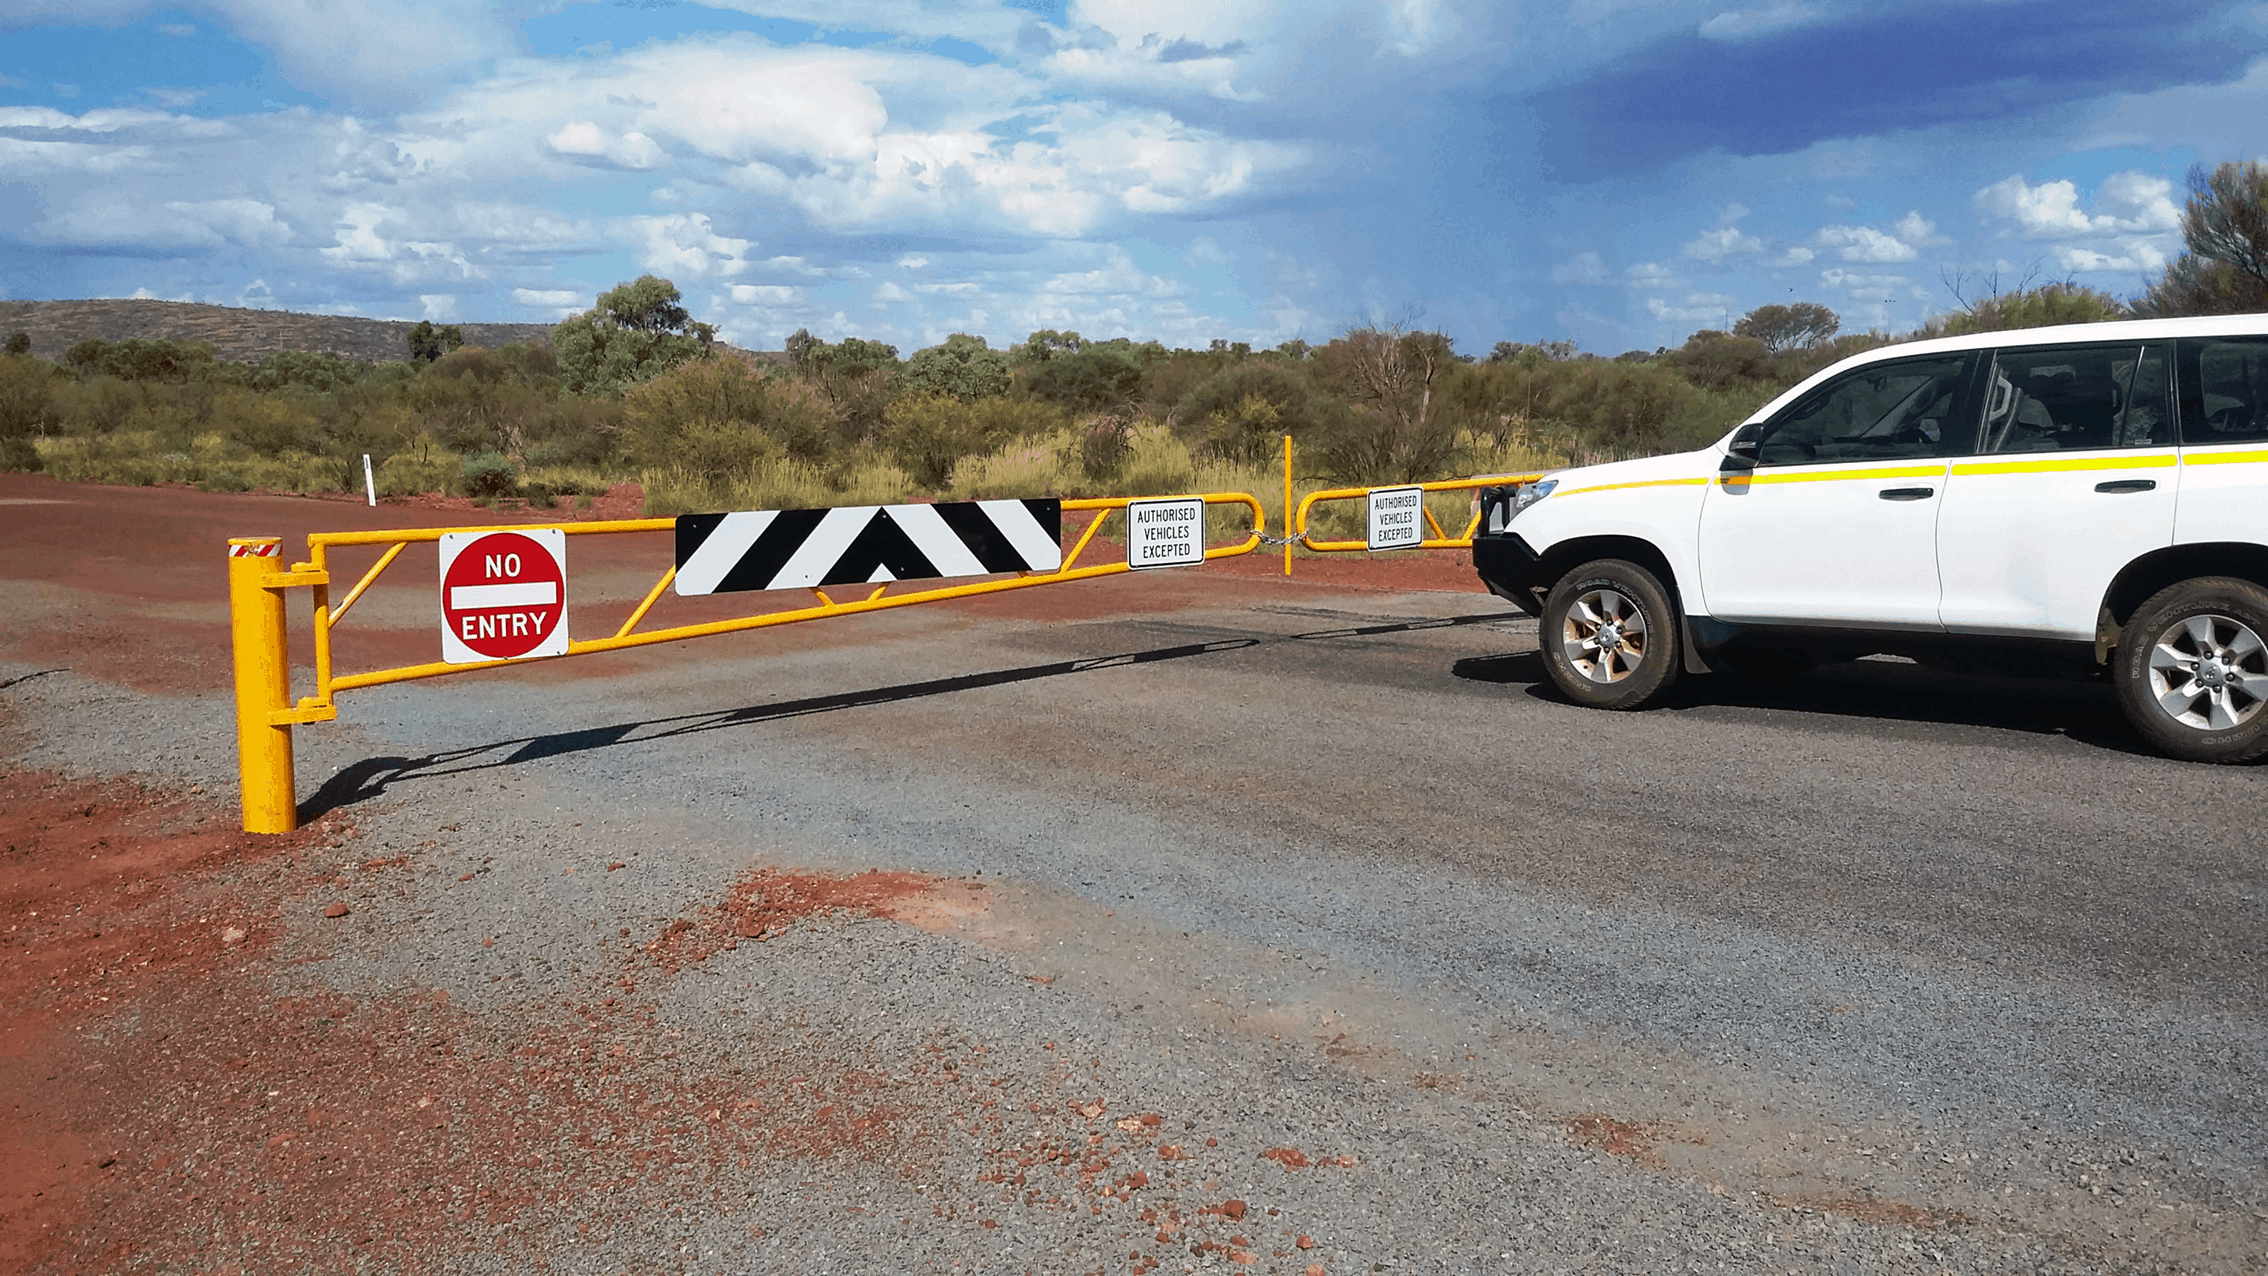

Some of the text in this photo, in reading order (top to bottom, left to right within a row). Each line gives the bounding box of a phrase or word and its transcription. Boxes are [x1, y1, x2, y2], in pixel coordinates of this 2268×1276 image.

[1374, 495, 1418, 510] AUTHORISED
[1137, 507, 1196, 524] AUTHORISED
[1379, 511, 1413, 525] VEHICLES
[1144, 525, 1190, 541] VEHICLES
[1378, 527, 1413, 542] EXCEPTED
[1143, 543, 1191, 559] EXCEPTED
[485, 553, 521, 578] NO
[462, 610, 547, 640] ENTRY
[2132, 635, 2149, 679] ROAD
